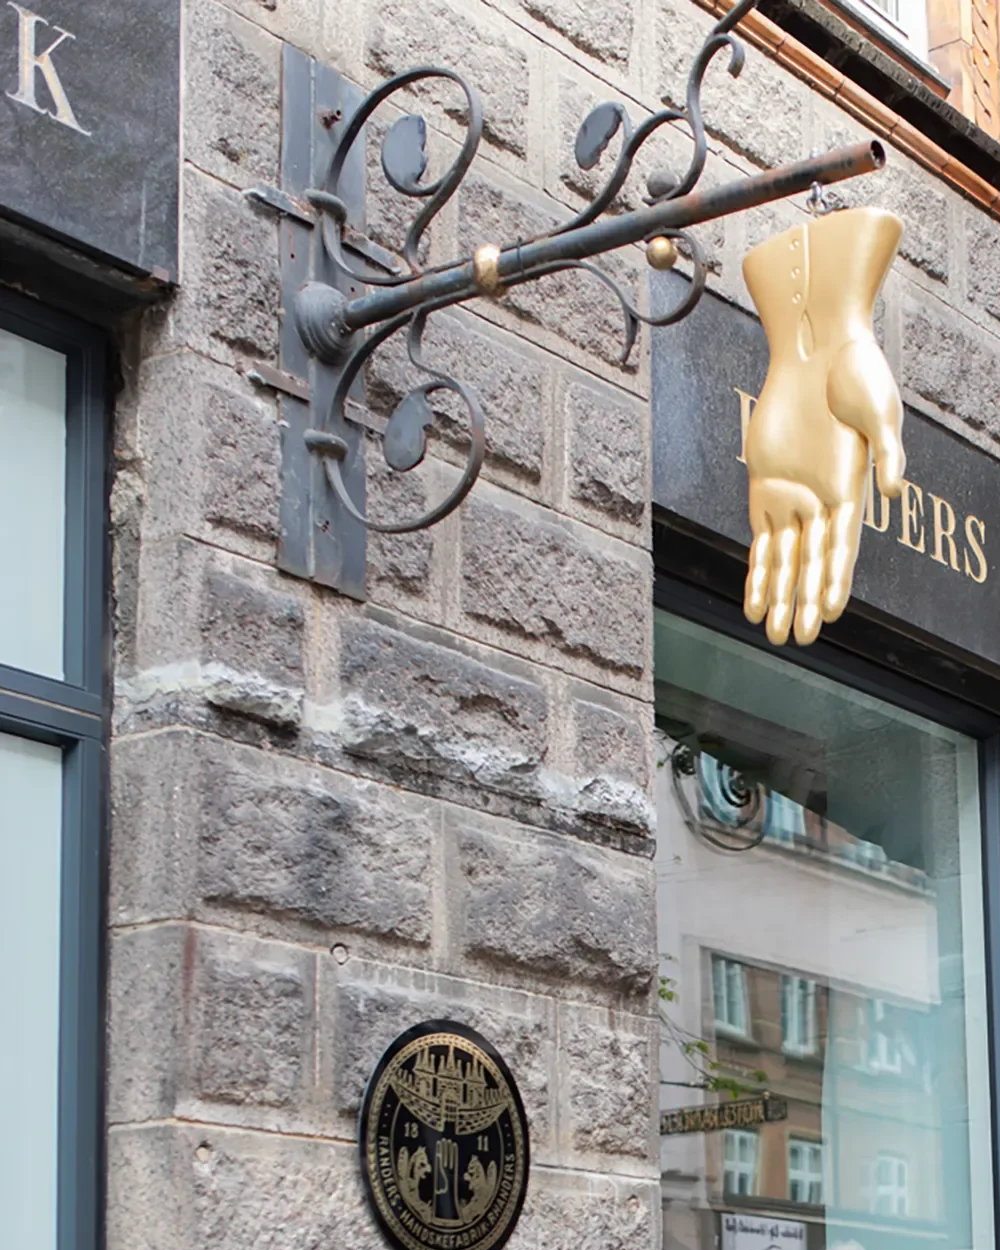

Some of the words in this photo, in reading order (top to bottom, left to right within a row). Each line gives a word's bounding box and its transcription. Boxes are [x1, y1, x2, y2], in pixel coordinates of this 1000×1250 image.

[5, 1, 92, 136] K
[378, 1136, 402, 1207] RANDERS
[486, 1153, 516, 1224] RHANDERS
